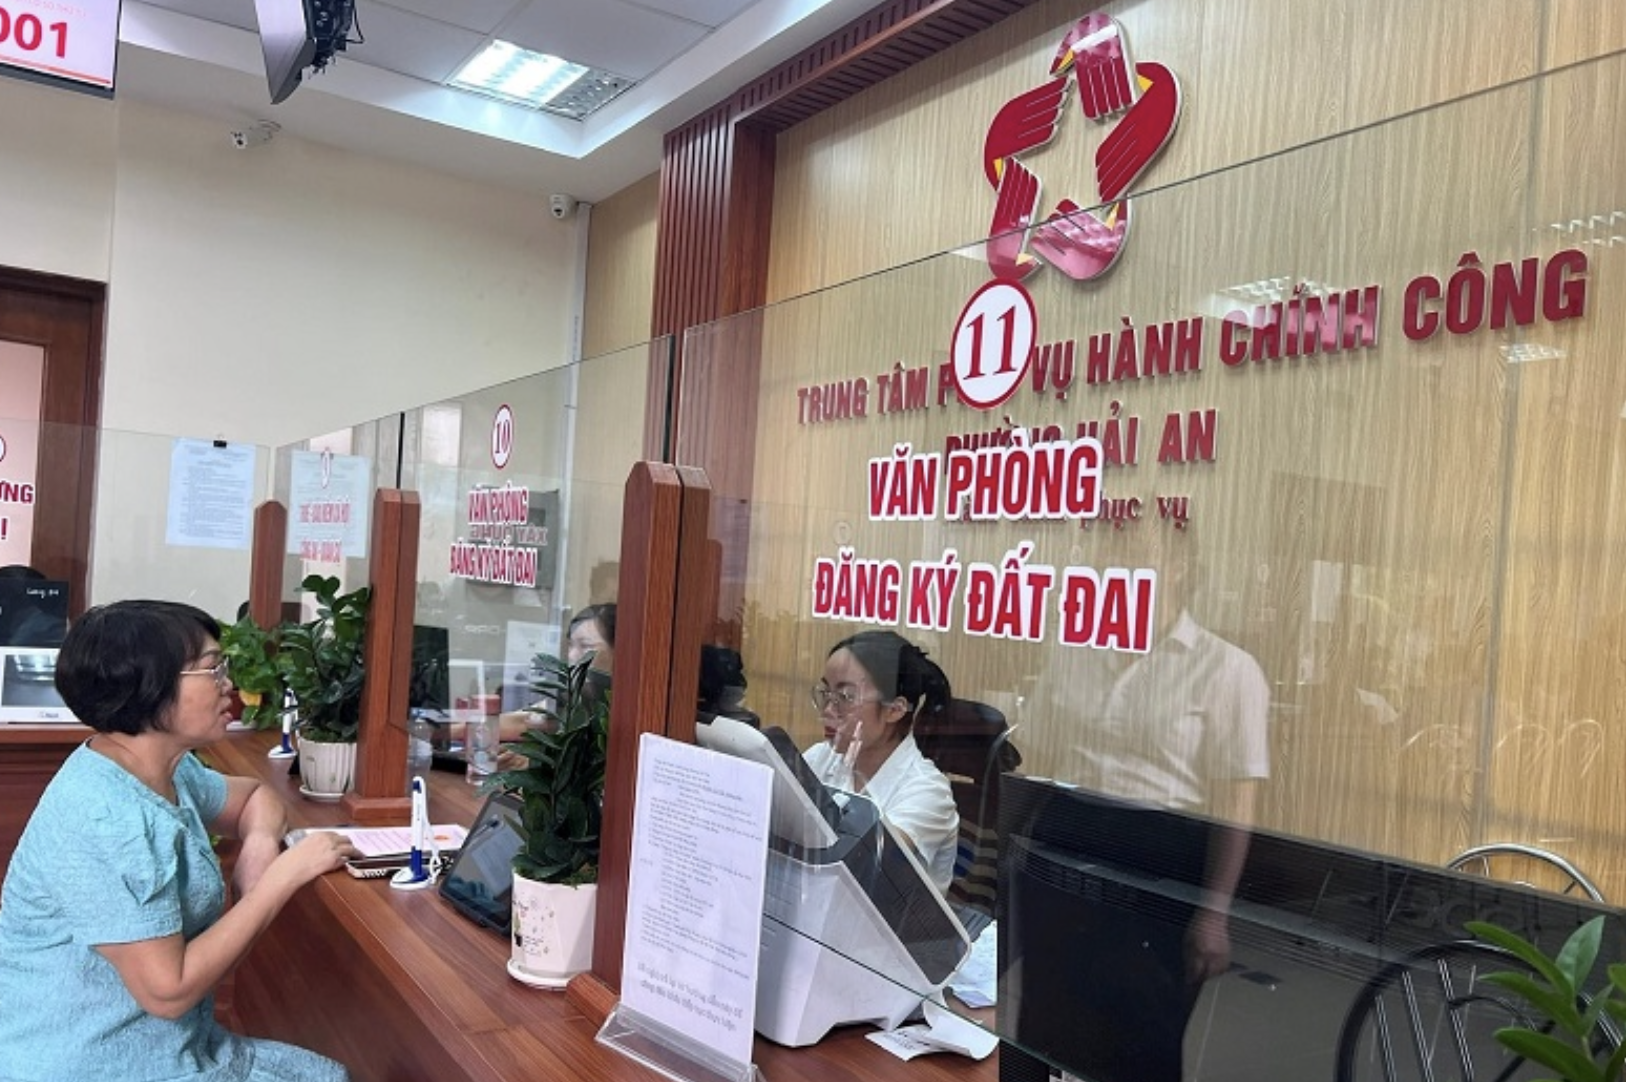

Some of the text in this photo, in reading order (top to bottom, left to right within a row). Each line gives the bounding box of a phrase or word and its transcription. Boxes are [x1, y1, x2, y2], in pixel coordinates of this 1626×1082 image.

[797, 378, 868, 424] TRUNG
[877, 362, 928, 412] TÂM
[1032, 340, 1075, 399] VỤ
[1087, 316, 1203, 384] HÀNH
[1219, 283, 1380, 366] CHÍNH
[1403, 249, 1588, 340] CÔNG
[963, 305, 1017, 381] 11
[494, 419, 511, 455] 10
[1158, 409, 1217, 464] AN
[870, 446, 936, 517] VĂN
[948, 434, 1098, 516] PHÒNG
[1157, 496, 1188, 529] vụ
[814, 548, 1151, 651] ĐĂNG KÝ ĐẤT ĐAI
